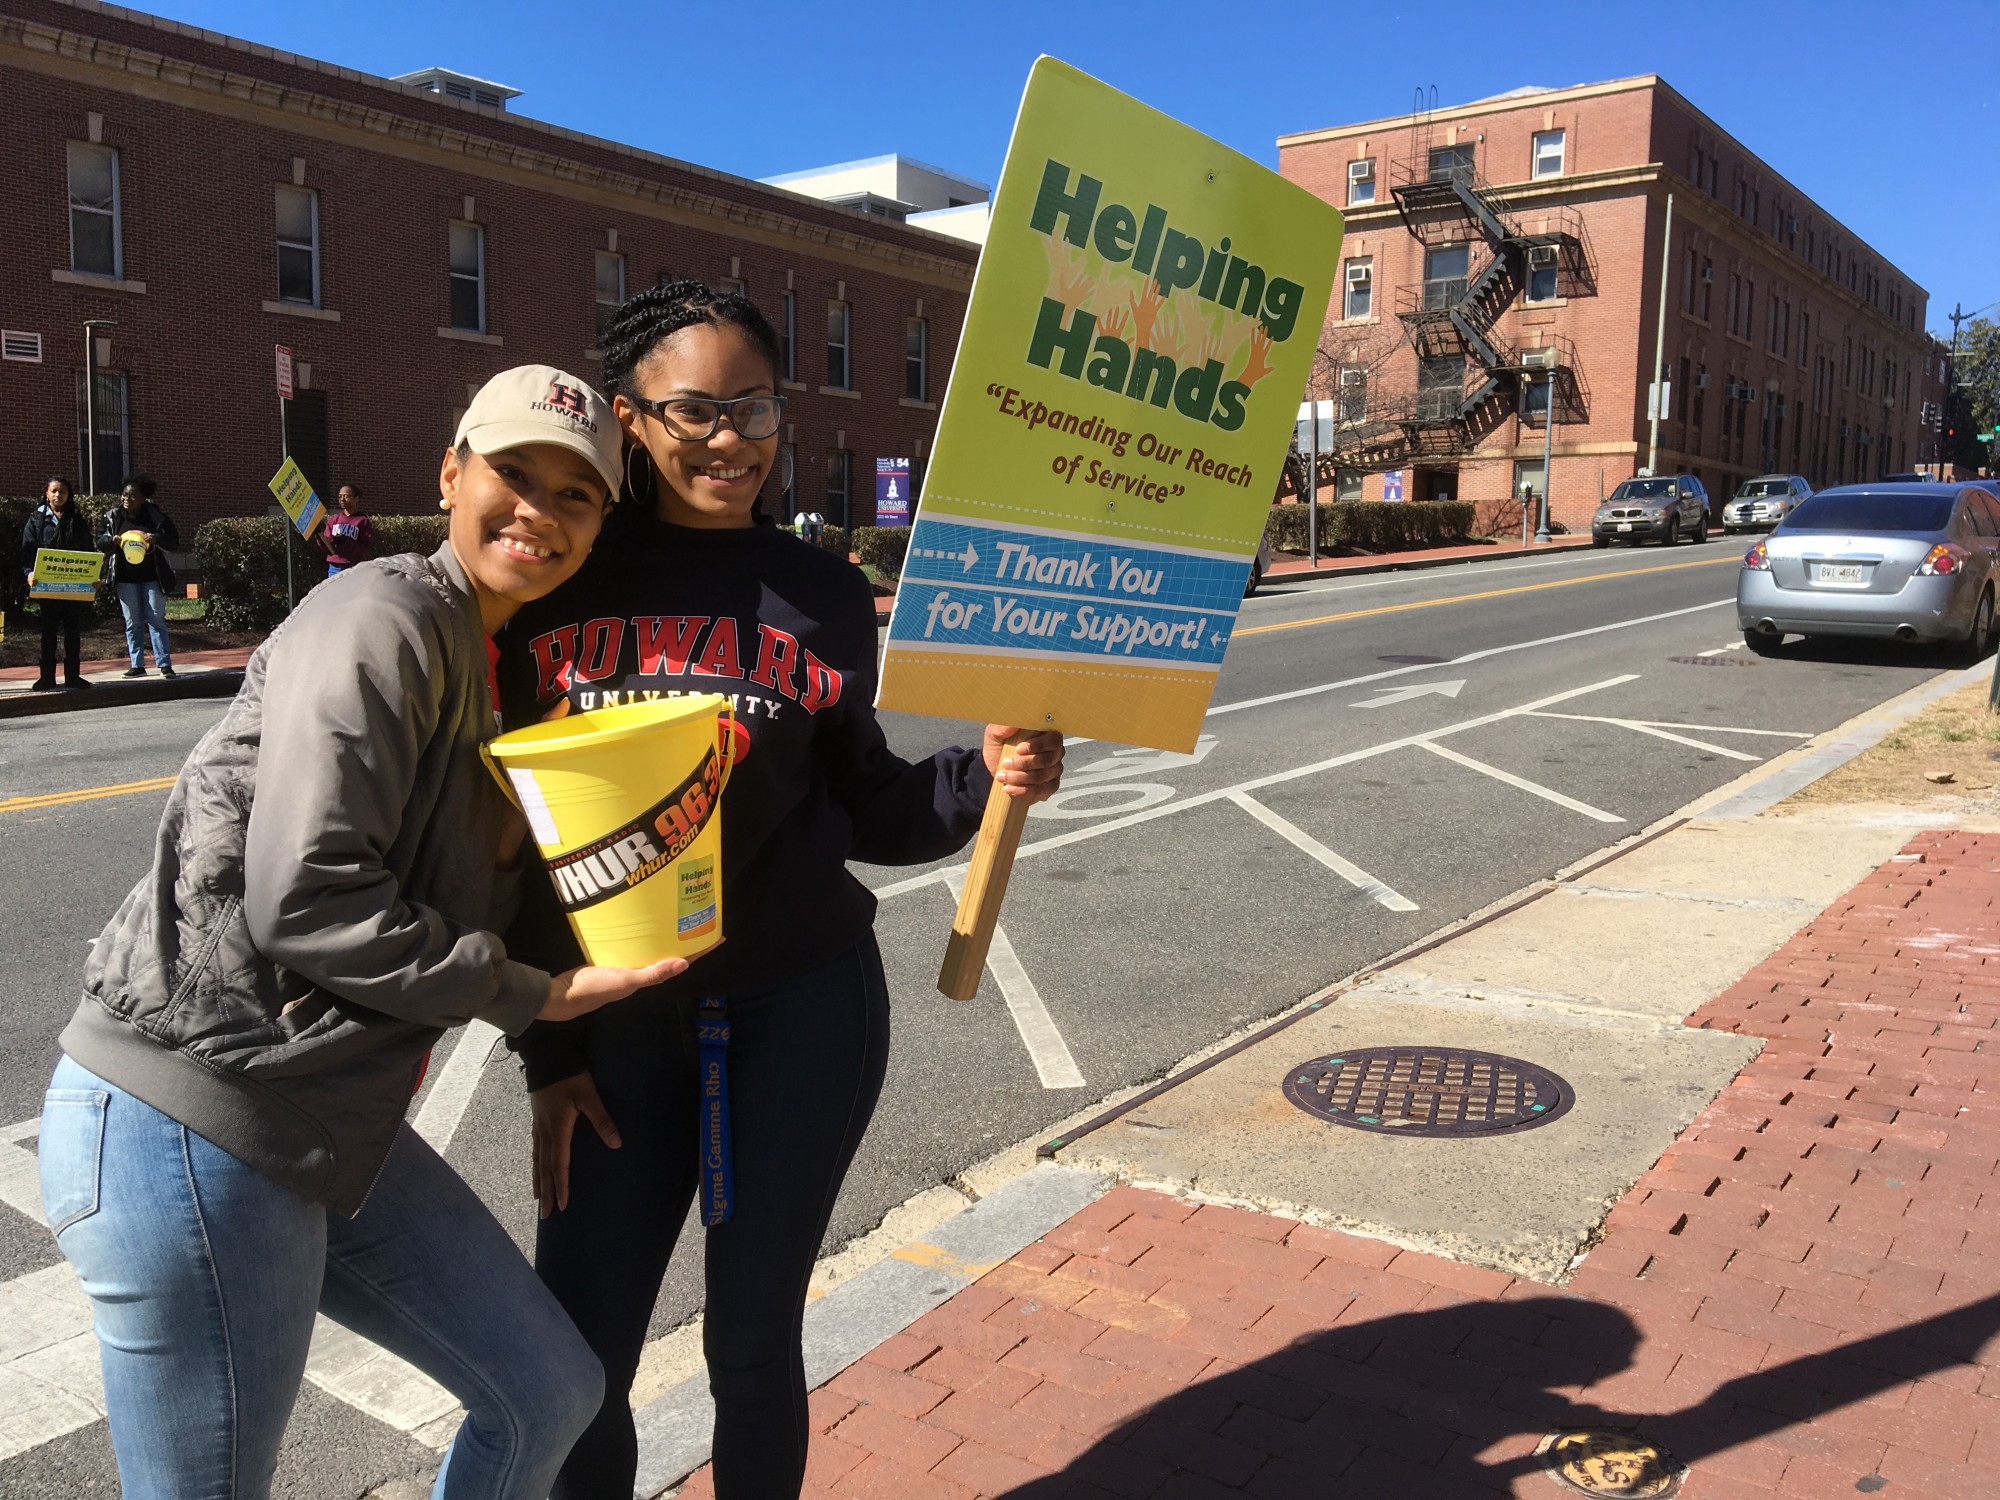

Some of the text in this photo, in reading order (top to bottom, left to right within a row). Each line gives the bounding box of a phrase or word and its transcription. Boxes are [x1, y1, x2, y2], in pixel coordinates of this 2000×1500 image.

[1030, 158, 1304, 342] Helping
[1027, 296, 1251, 431] Hands
[530, 402, 597, 433] HOWARD
[549, 383, 588, 417] H
[986, 382, 1253, 488] “Expanding Our Reach
[276, 467, 298, 495] Helping
[896, 458, 909, 467] 54
[1052, 455, 1084, 484] of
[285, 481, 302, 503] Hands
[42, 555, 97, 566] Helping
[46, 565, 90, 574] Hands
[995, 541, 1163, 595] Thank You
[924, 592, 1207, 654] for Your Support!
[528, 615, 843, 715] HOWARD
[654, 754, 720, 846] 96.3
[555, 823, 640, 867] UNIVERSITY RADIO
[625, 824, 699, 887] whur.com
[681, 866, 713, 882] Helping
[685, 881, 712, 895] Hands
[706, 1062, 728, 1226] Sigma Gamma Rho
